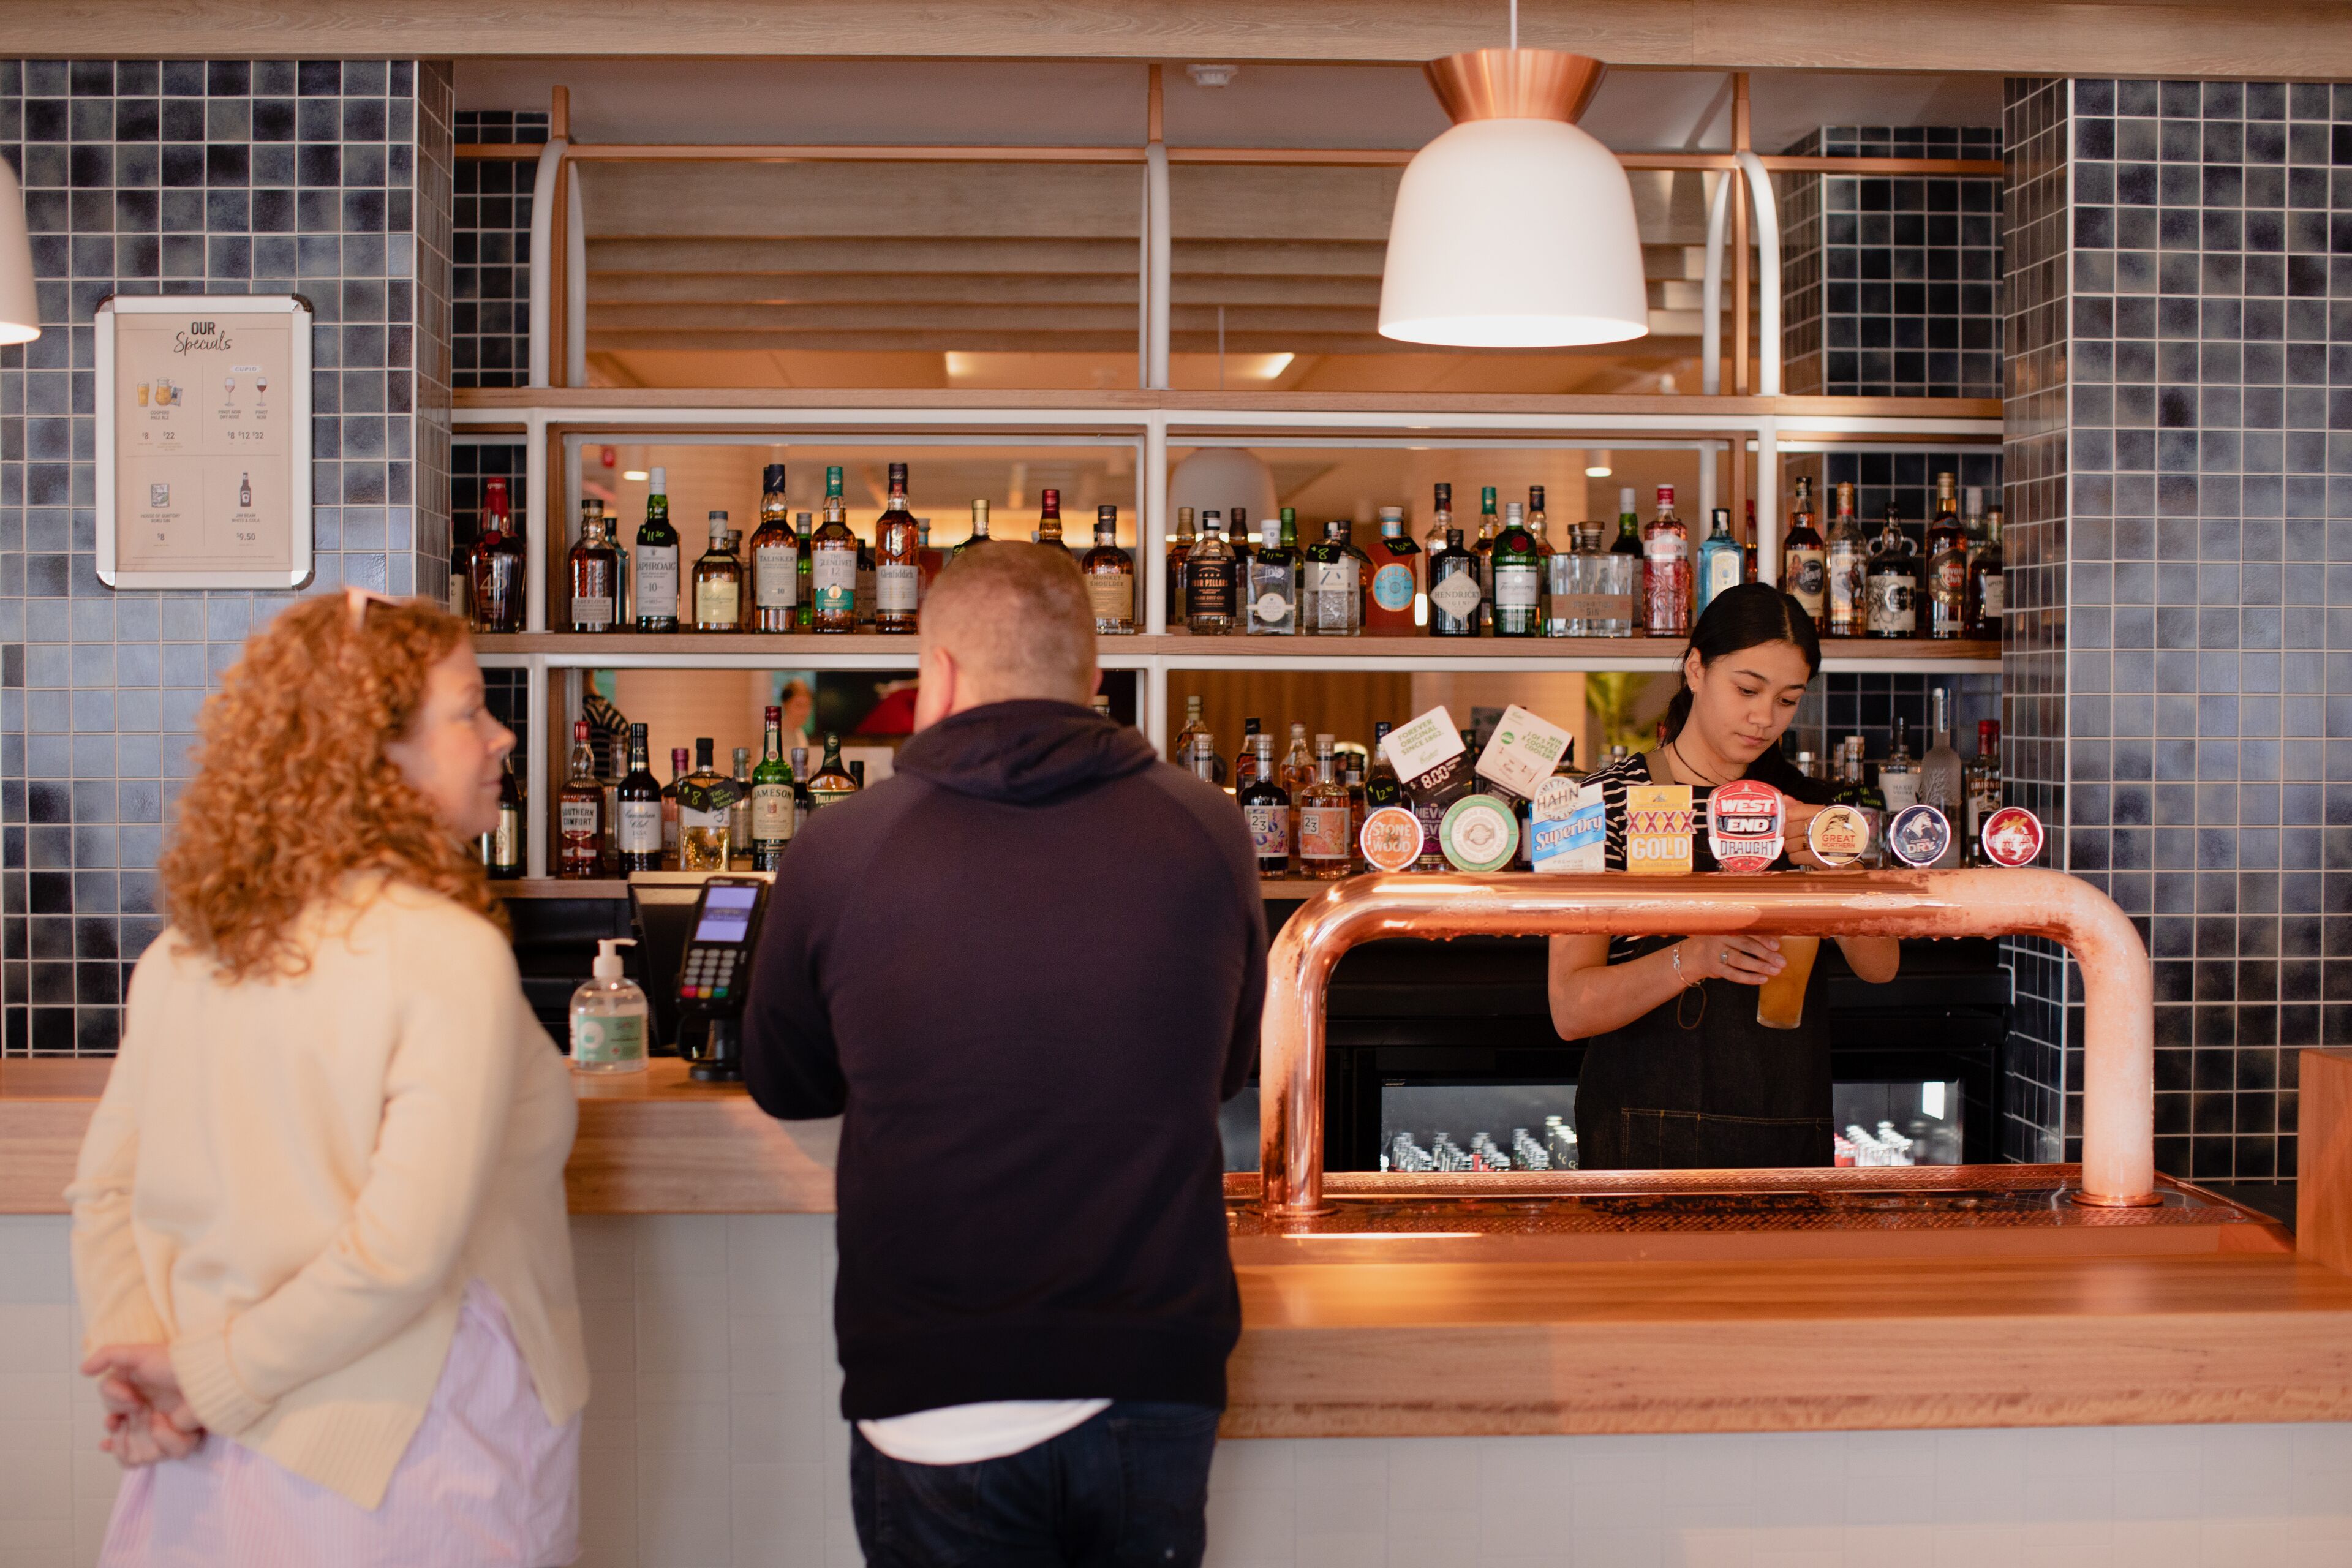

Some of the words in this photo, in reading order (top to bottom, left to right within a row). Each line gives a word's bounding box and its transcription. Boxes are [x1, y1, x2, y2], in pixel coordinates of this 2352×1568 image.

[191, 322, 216, 335] OUR
[173, 330, 233, 356] Specials
[163, 431, 175, 440] $22
[1311, 546, 1329, 560] $8
[881, 569, 914, 579] Glenfiddich
[1945, 575, 1961, 584] Club
[649, 582, 657, 592] 10
[1398, 718, 1433, 742] FOREVER
[1400, 725, 1438, 748] ORIGINAL
[1531, 733, 1541, 742] OF
[1549, 735, 1564, 746] WIN
[1401, 739, 1424, 756] SINCE
[1525, 743, 1555, 762] COOLERS
[1526, 737, 1558, 757] COOPERS
[1420, 764, 1450, 790] 8.00
[753, 788, 792, 801] JAMESON
[1537, 785, 1579, 812] HAHN
[562, 808, 594, 816] SOUTHERN
[1720, 799, 1775, 813] WEST
[624, 809, 655, 819] Canadian
[1624, 810, 1697, 834] XXXX
[1726, 818, 1770, 832] END
[1372, 823, 1412, 837] STONE
[1535, 815, 1603, 851] SuperDry
[1372, 839, 1411, 853] WOOD
[1631, 837, 1689, 861] GOLD
[1720, 840, 1776, 856] DRAUGHT
[1906, 841, 1936, 854] DRY
